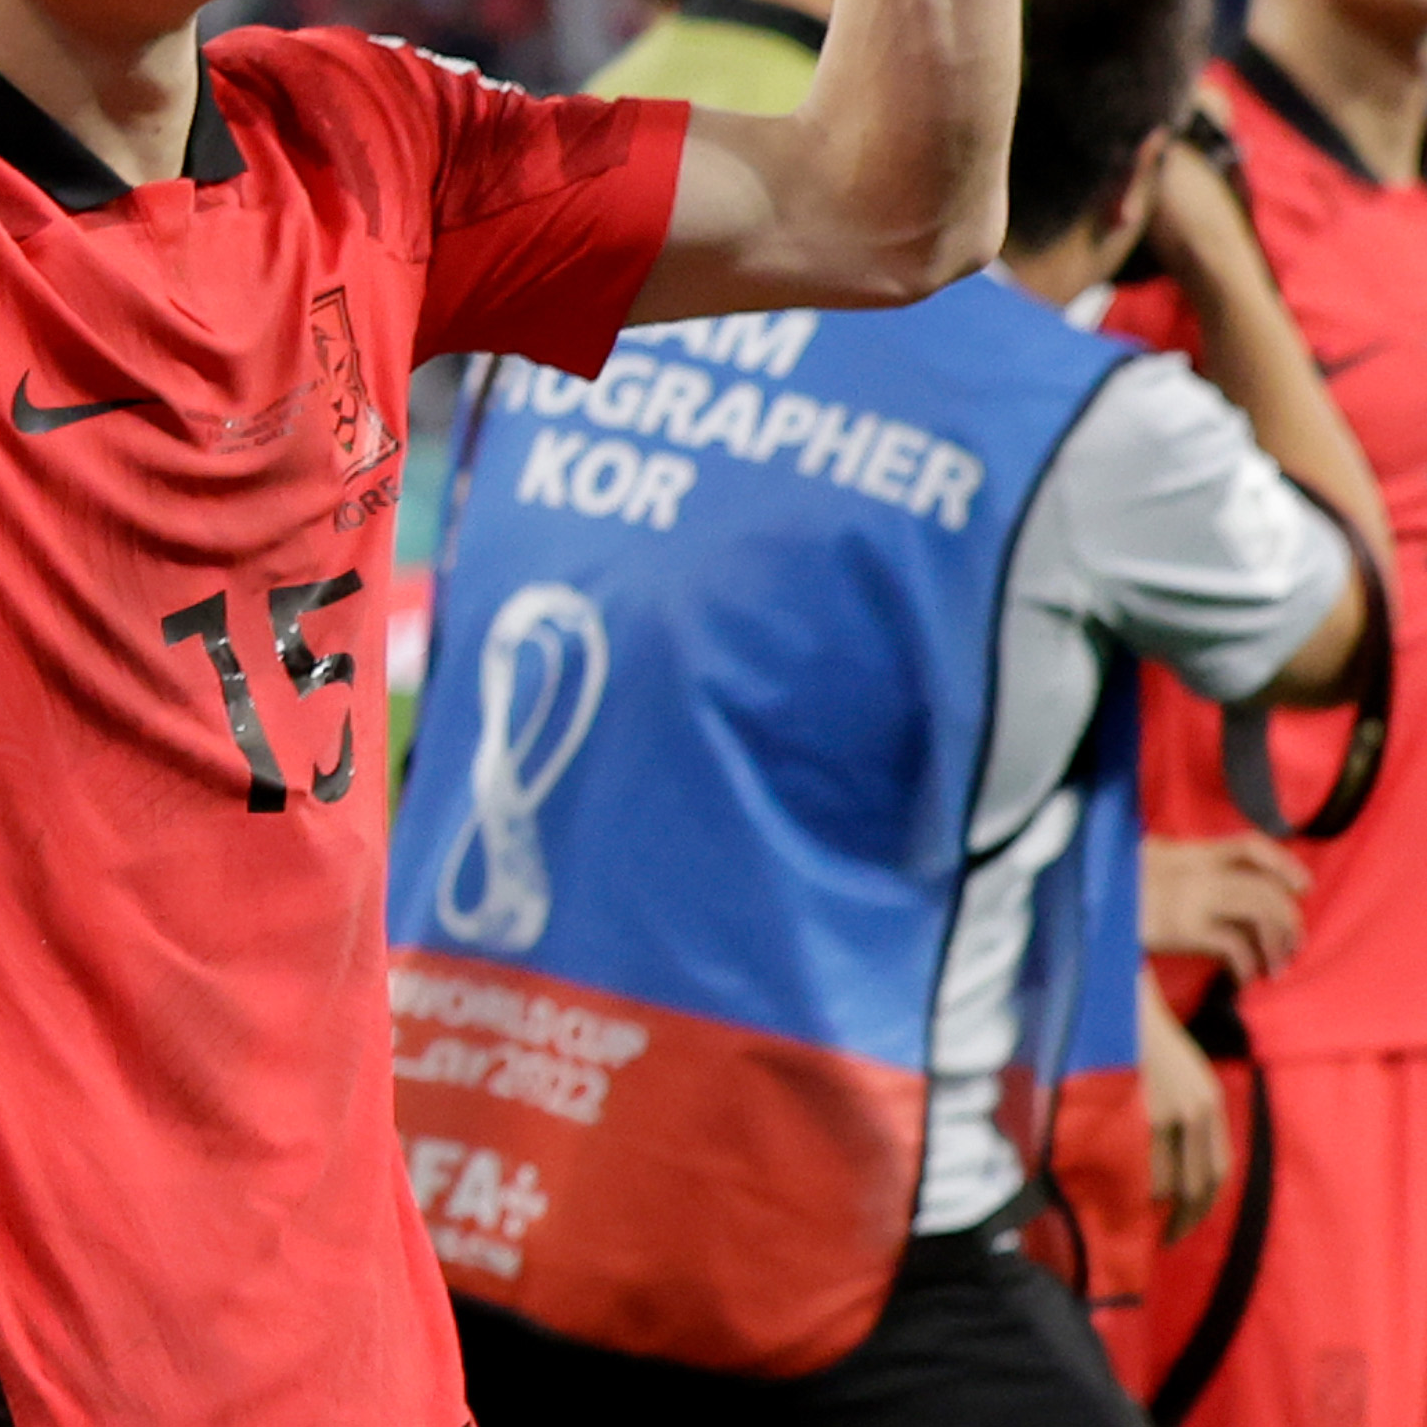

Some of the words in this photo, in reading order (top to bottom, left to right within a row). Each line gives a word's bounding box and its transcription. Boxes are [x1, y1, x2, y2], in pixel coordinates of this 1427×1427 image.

[333, 474, 400, 534] ORE
[515, 427, 698, 533] KOR
[161, 569, 363, 814] 15
[408, 1135, 549, 1240] FA+
